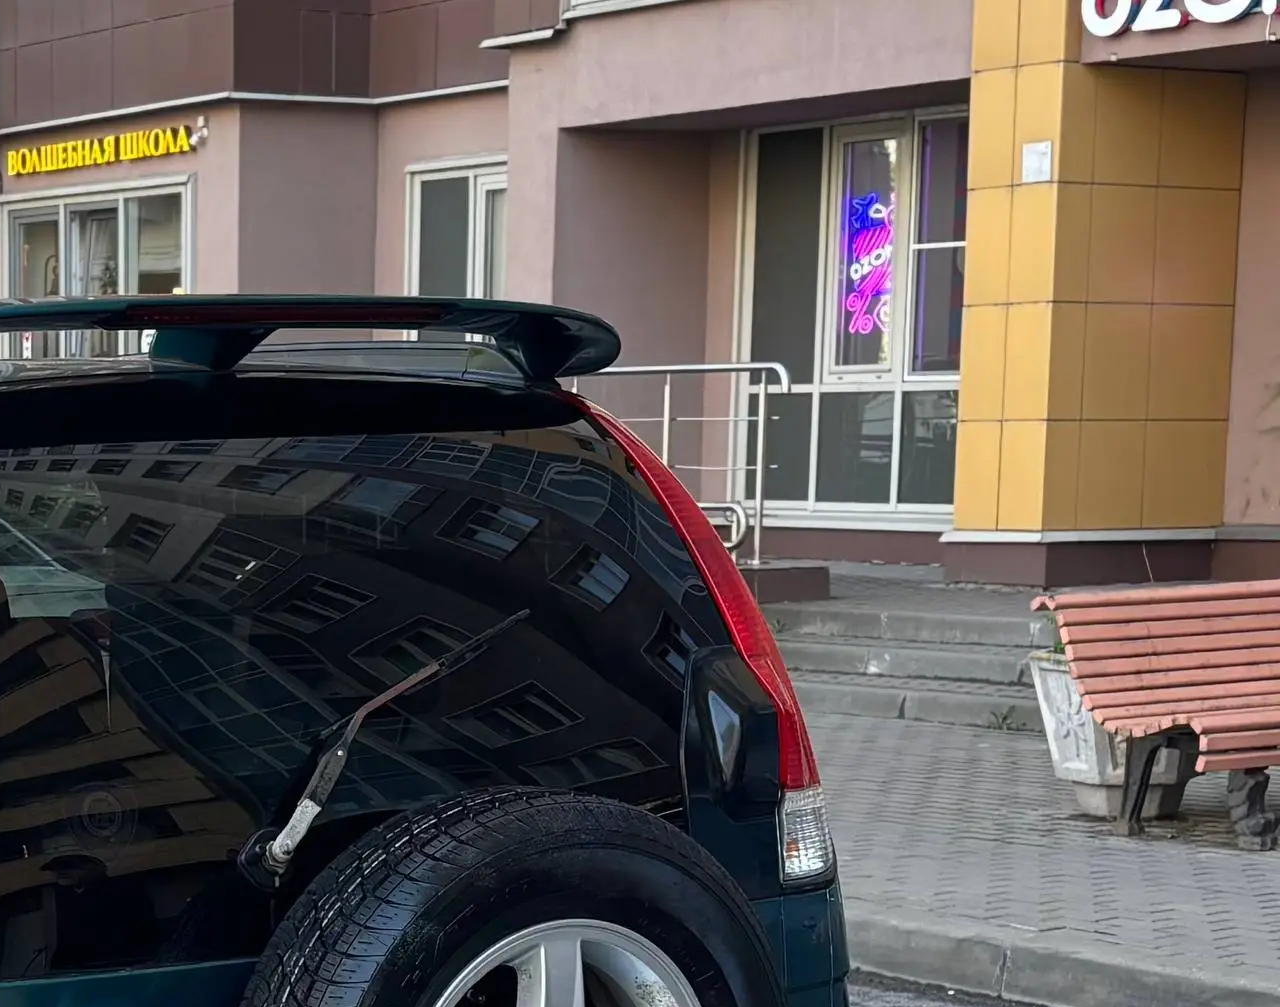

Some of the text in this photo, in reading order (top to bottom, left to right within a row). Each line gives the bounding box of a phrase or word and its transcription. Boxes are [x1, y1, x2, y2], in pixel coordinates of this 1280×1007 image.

[1081, 0, 1277, 37] OZ
[7, 125, 190, 176] ВОЛШЕБНАЯ ШКОЛА
